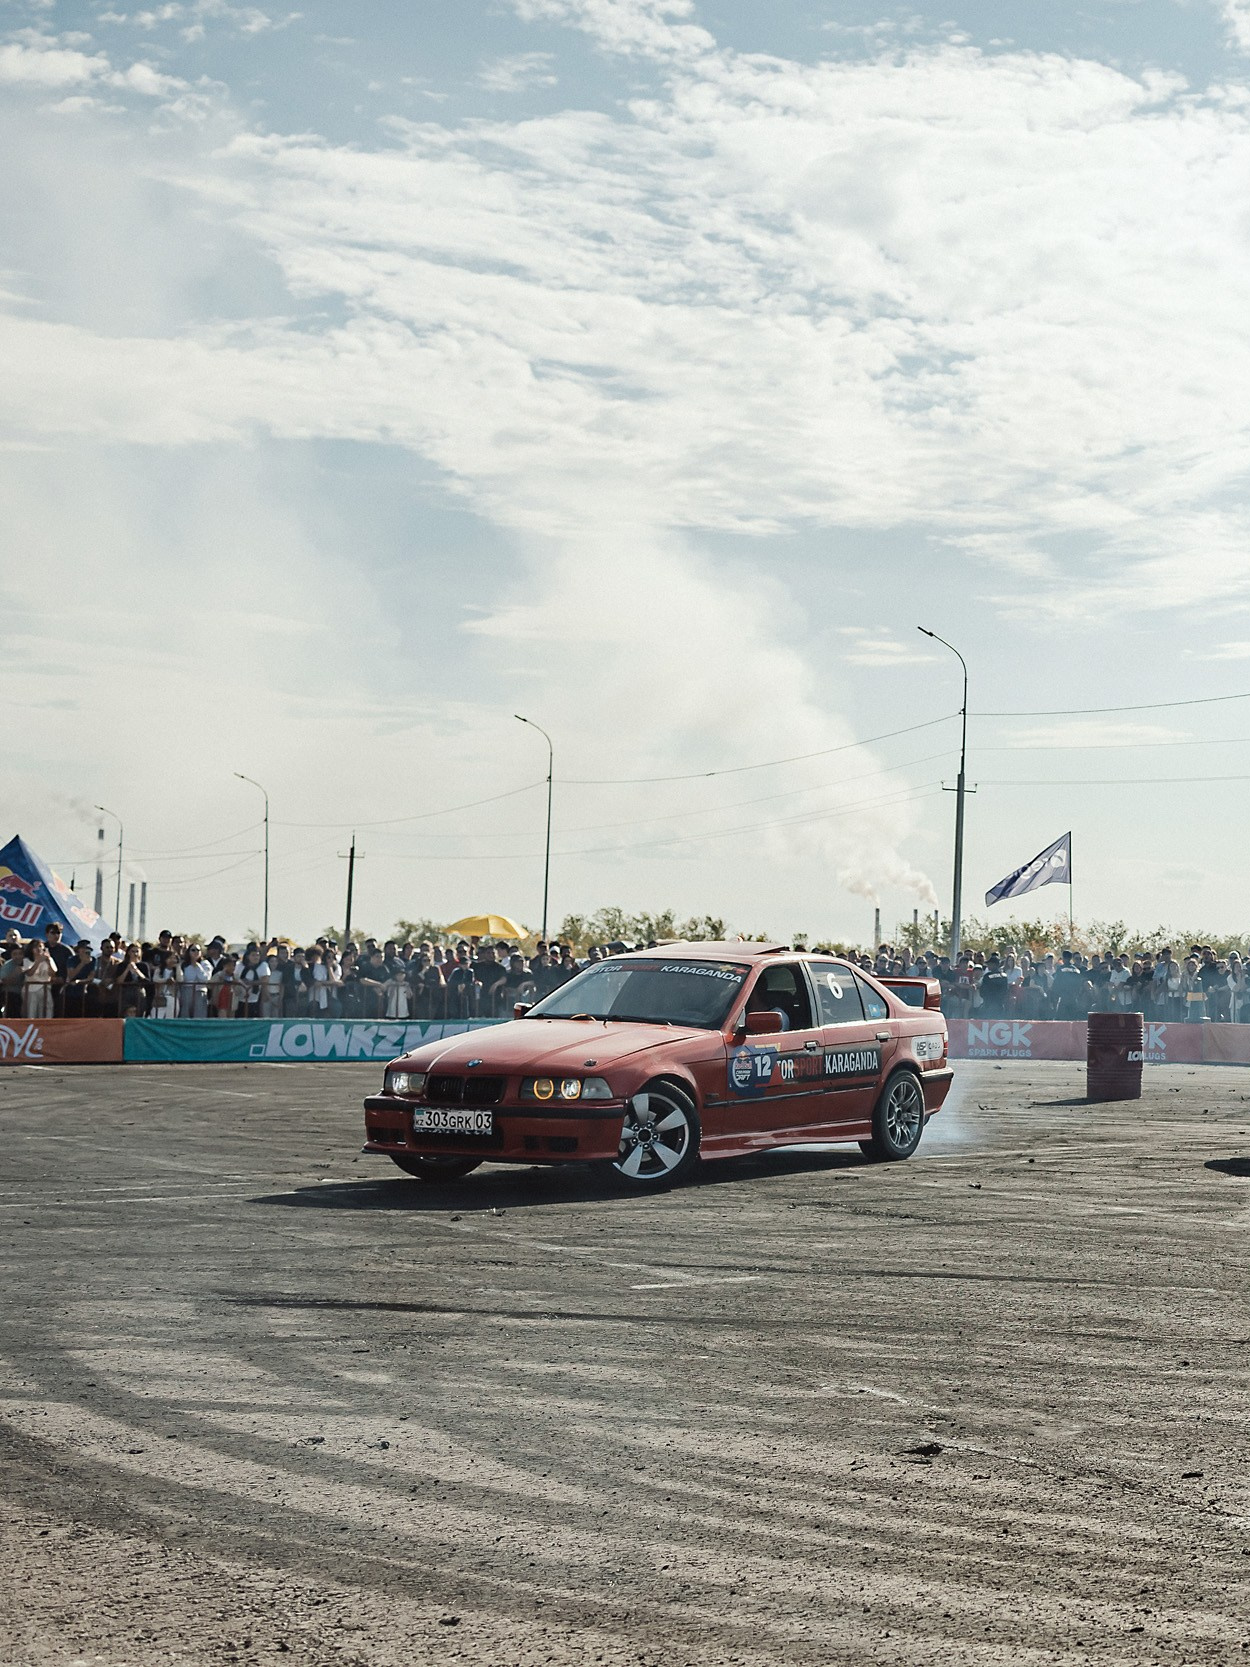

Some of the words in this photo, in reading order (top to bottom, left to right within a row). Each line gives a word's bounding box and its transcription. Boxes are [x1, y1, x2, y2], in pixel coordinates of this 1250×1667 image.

[660, 965, 742, 983] KARAGANDA
[827, 973, 843, 999] 6
[968, 1021, 1033, 1048] NGK
[825, 1051, 879, 1074] KARAGANDA
[968, 1048, 998, 1057] SPARK
[1000, 1049, 1032, 1057] PLUGS
[754, 1055, 771, 1077] 12
[475, 1113, 492, 1129] 03
